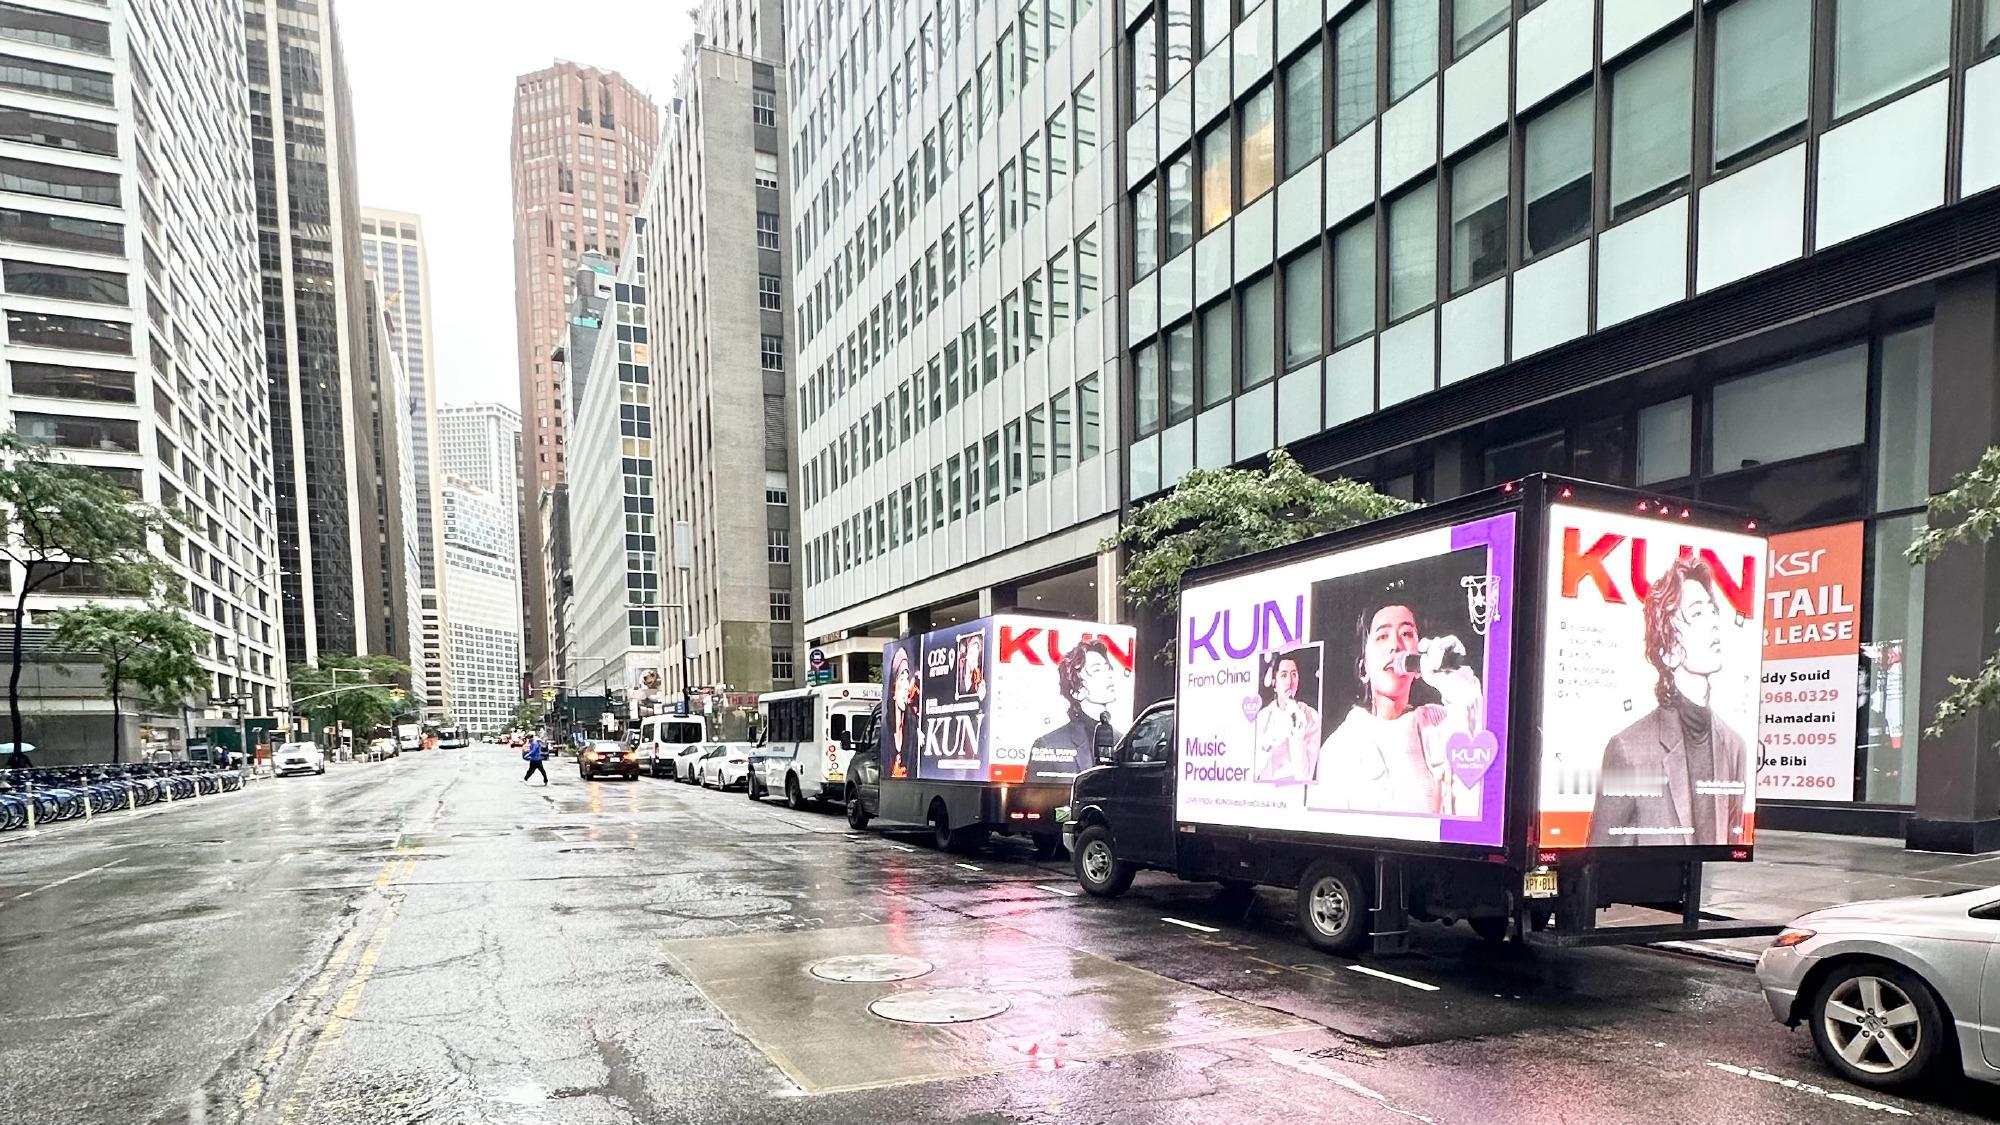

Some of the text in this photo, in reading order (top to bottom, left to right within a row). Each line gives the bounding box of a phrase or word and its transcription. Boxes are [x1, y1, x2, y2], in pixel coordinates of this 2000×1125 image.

[1769, 549, 1826, 578] ksr
[1189, 595, 1304, 664] KUN
[1775, 620, 1854, 645] LEASE
[1188, 667, 1251, 688] From China
[1790, 670, 1831, 682] Souid
[1765, 712, 1836, 724] Hamadani
[924, 714, 985, 756] KUN
[1186, 735, 1226, 756] Music
[996, 748, 1026, 759] COS
[1452, 748, 1491, 762] KUN
[1780, 756, 1807, 766] Bibi
[1185, 760, 1250, 781] Producer
